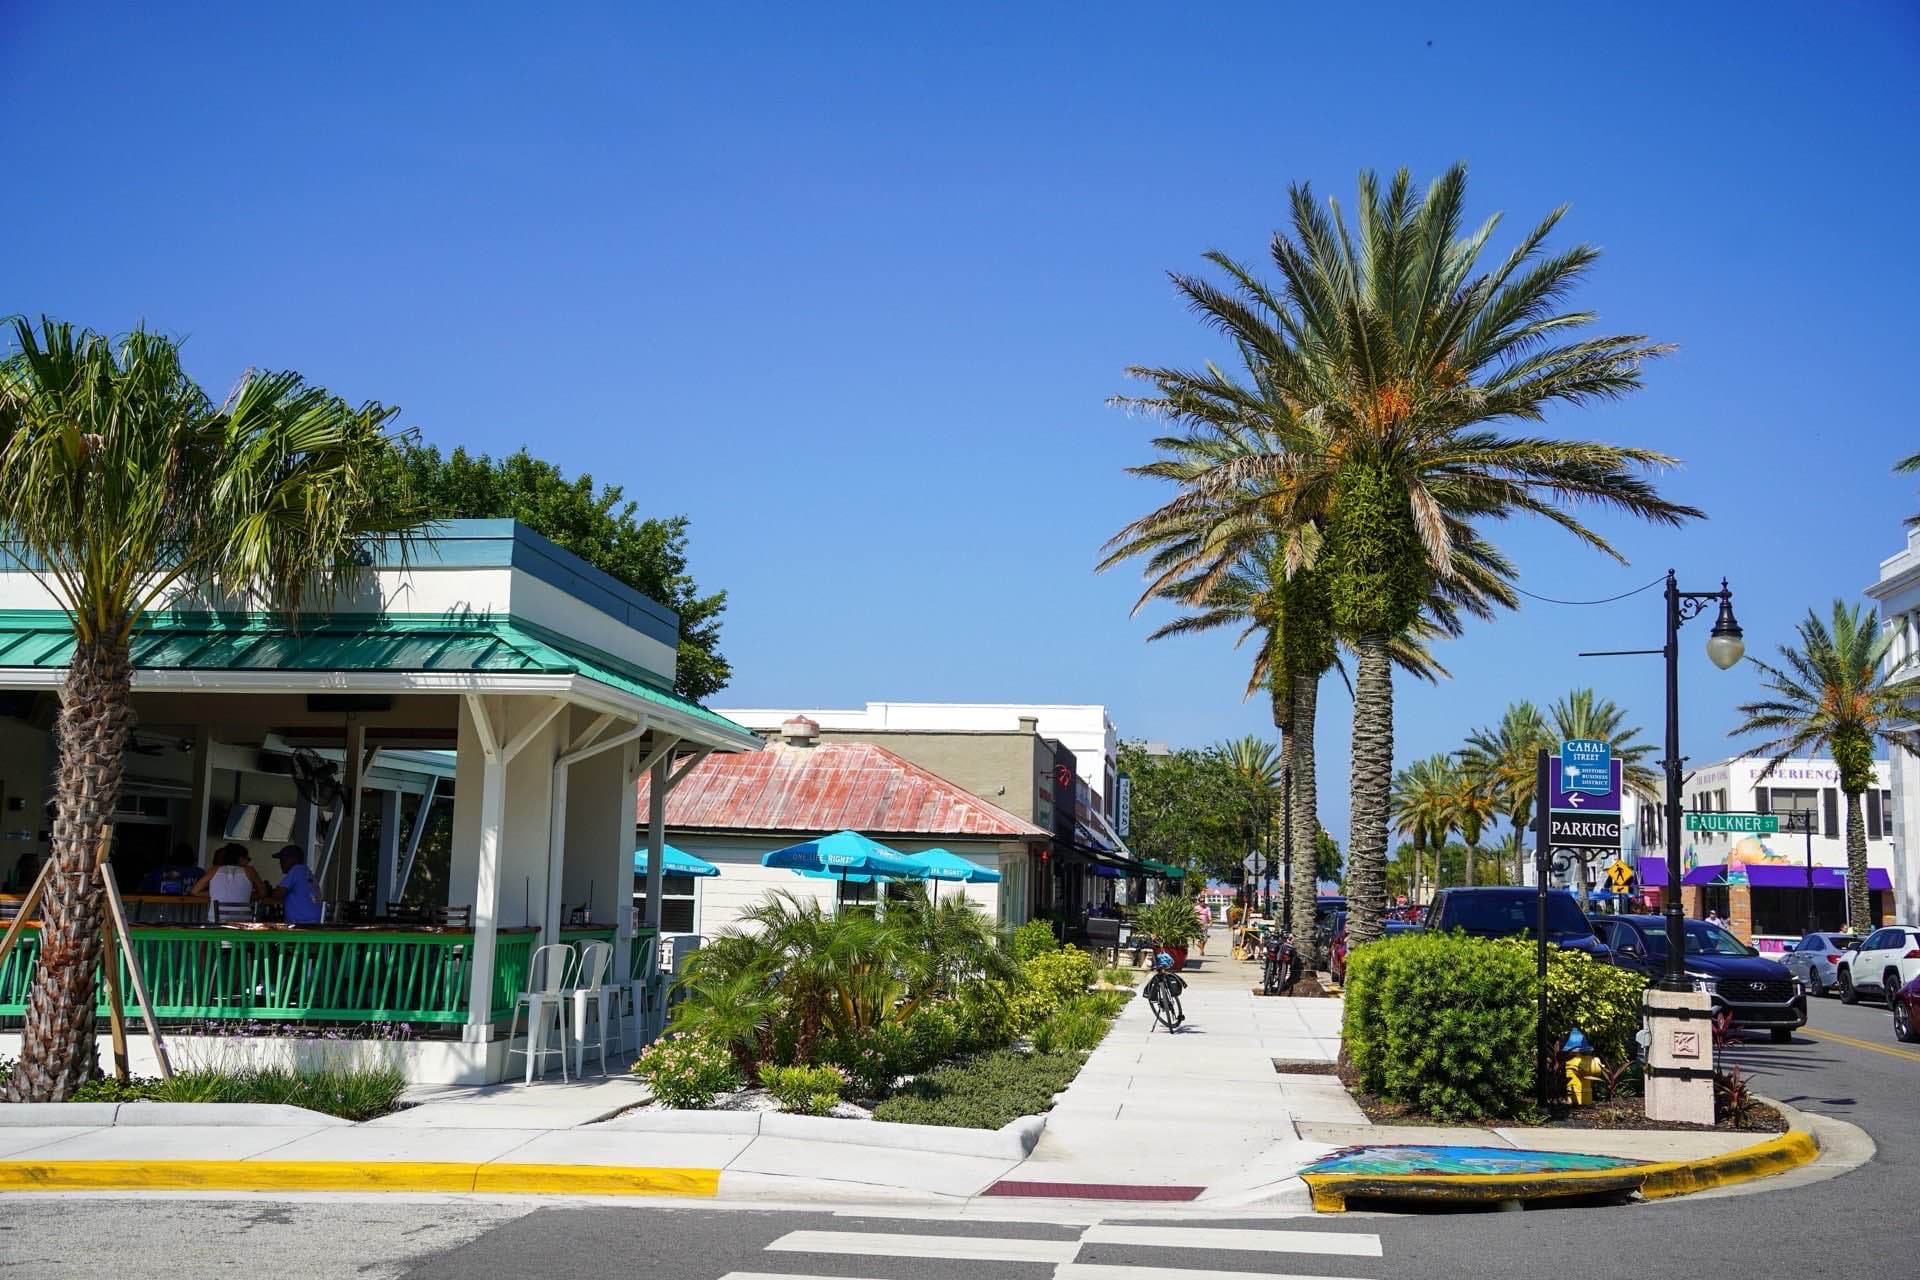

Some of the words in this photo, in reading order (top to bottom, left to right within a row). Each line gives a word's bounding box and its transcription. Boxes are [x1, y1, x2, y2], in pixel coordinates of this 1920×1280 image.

[1567, 742, 1606, 753] CANAL
[1573, 753, 1600, 761] STREET
[1552, 821, 1619, 837] PARKING
[1690, 816, 1761, 831] FAULKNER
